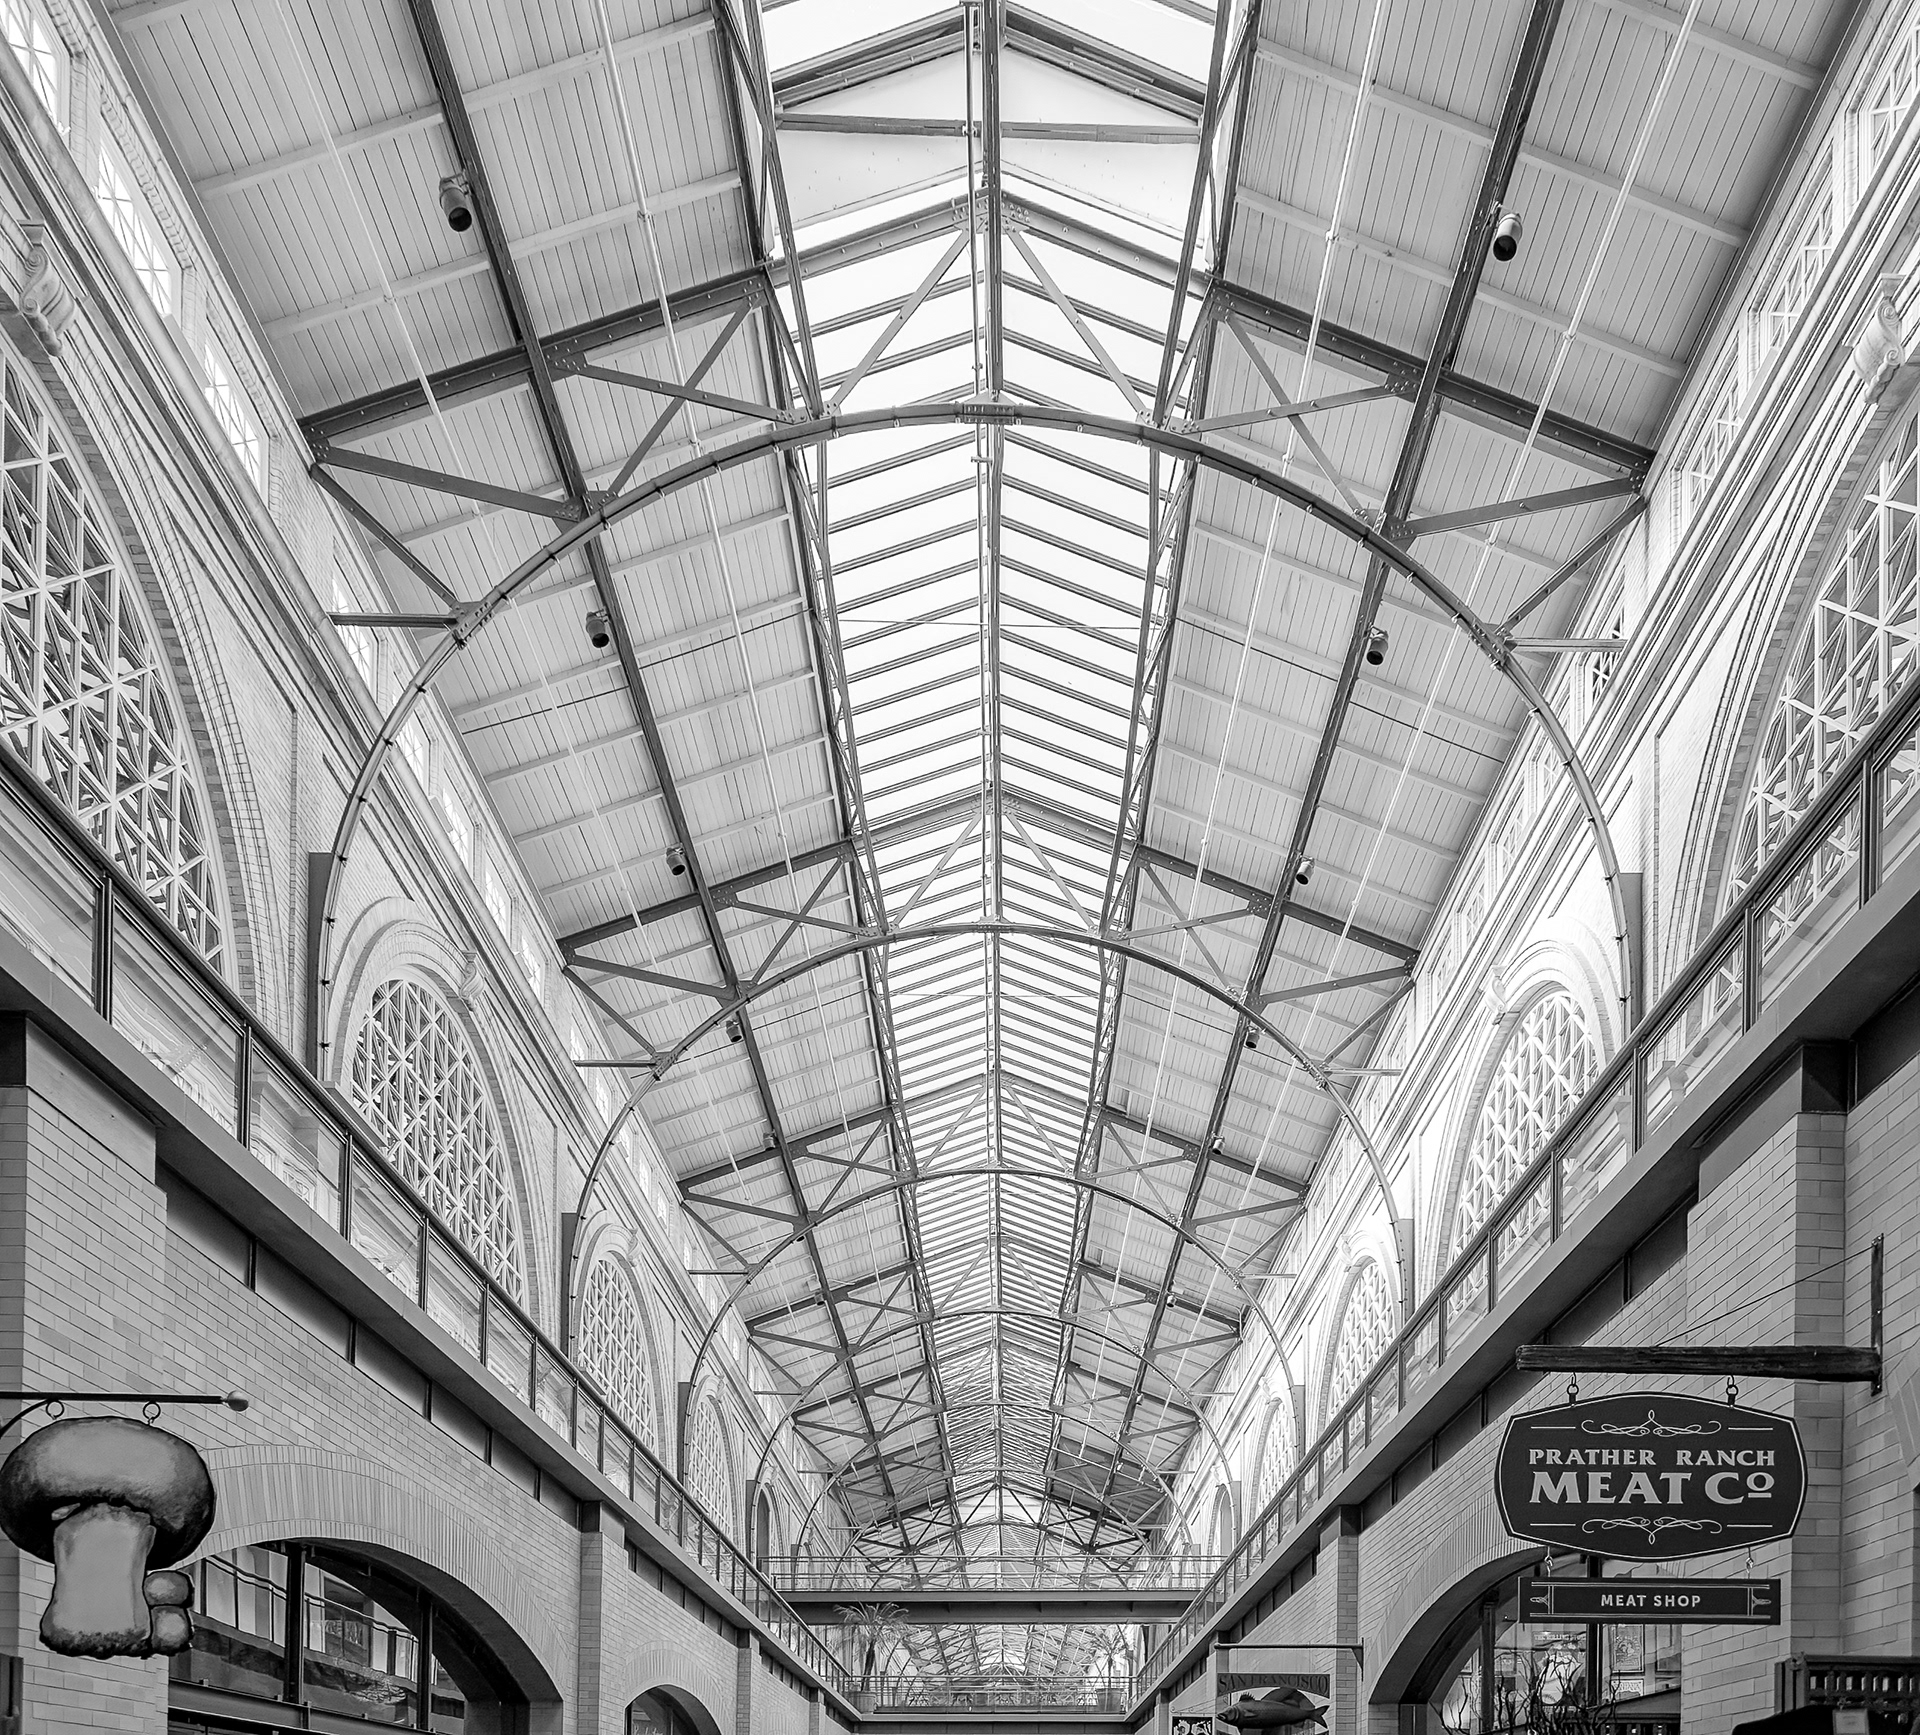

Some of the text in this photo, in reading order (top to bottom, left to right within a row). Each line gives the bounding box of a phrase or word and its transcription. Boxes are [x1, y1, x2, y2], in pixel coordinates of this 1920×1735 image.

[1529, 1449, 1775, 1467] PRATHER RANCH
[1529, 1471, 1692, 1505] MEAT
[1601, 1595, 1701, 1607] MEAT SHOP
[1218, 1674, 1329, 1695] SAN FRANCISCO
